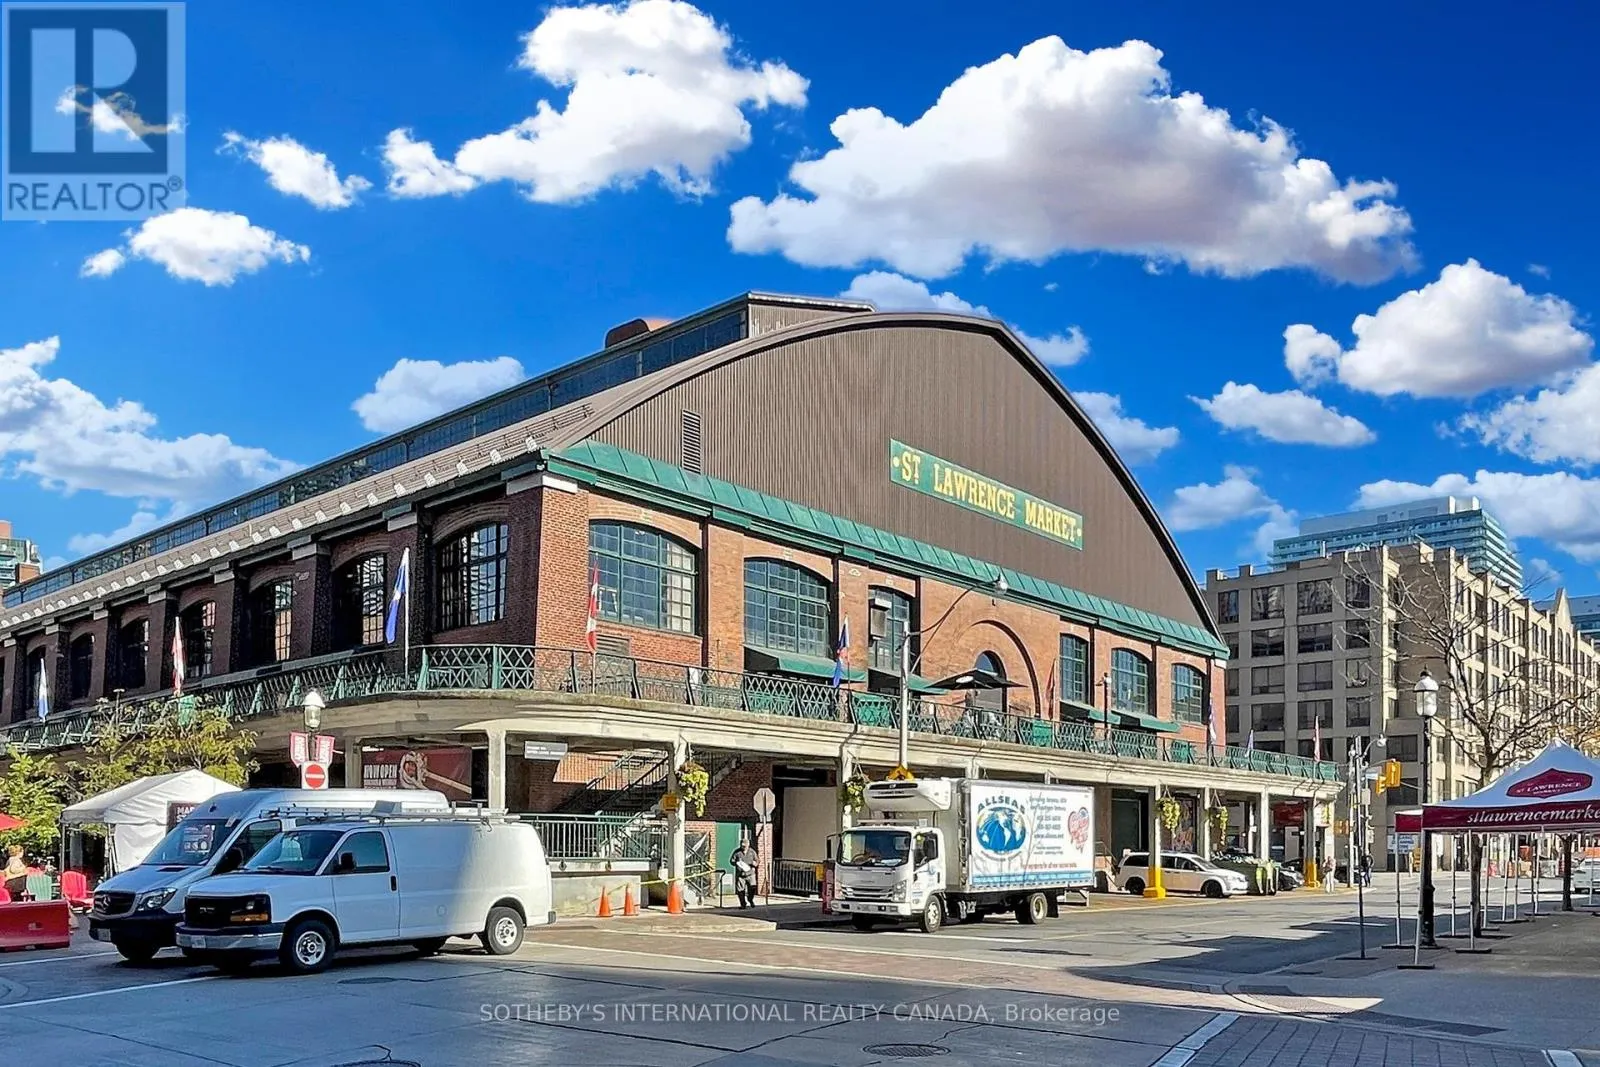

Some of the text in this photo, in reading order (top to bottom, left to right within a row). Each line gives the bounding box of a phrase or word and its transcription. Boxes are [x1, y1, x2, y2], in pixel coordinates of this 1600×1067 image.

[934, 463, 1016, 520] LAWRENCE
[1024, 499, 1077, 542] MARKET
[380, 764, 398, 778] OPEN
[1526, 782, 1582, 792] LAWRENCE
[977, 795, 1026, 815] ALLSEAS
